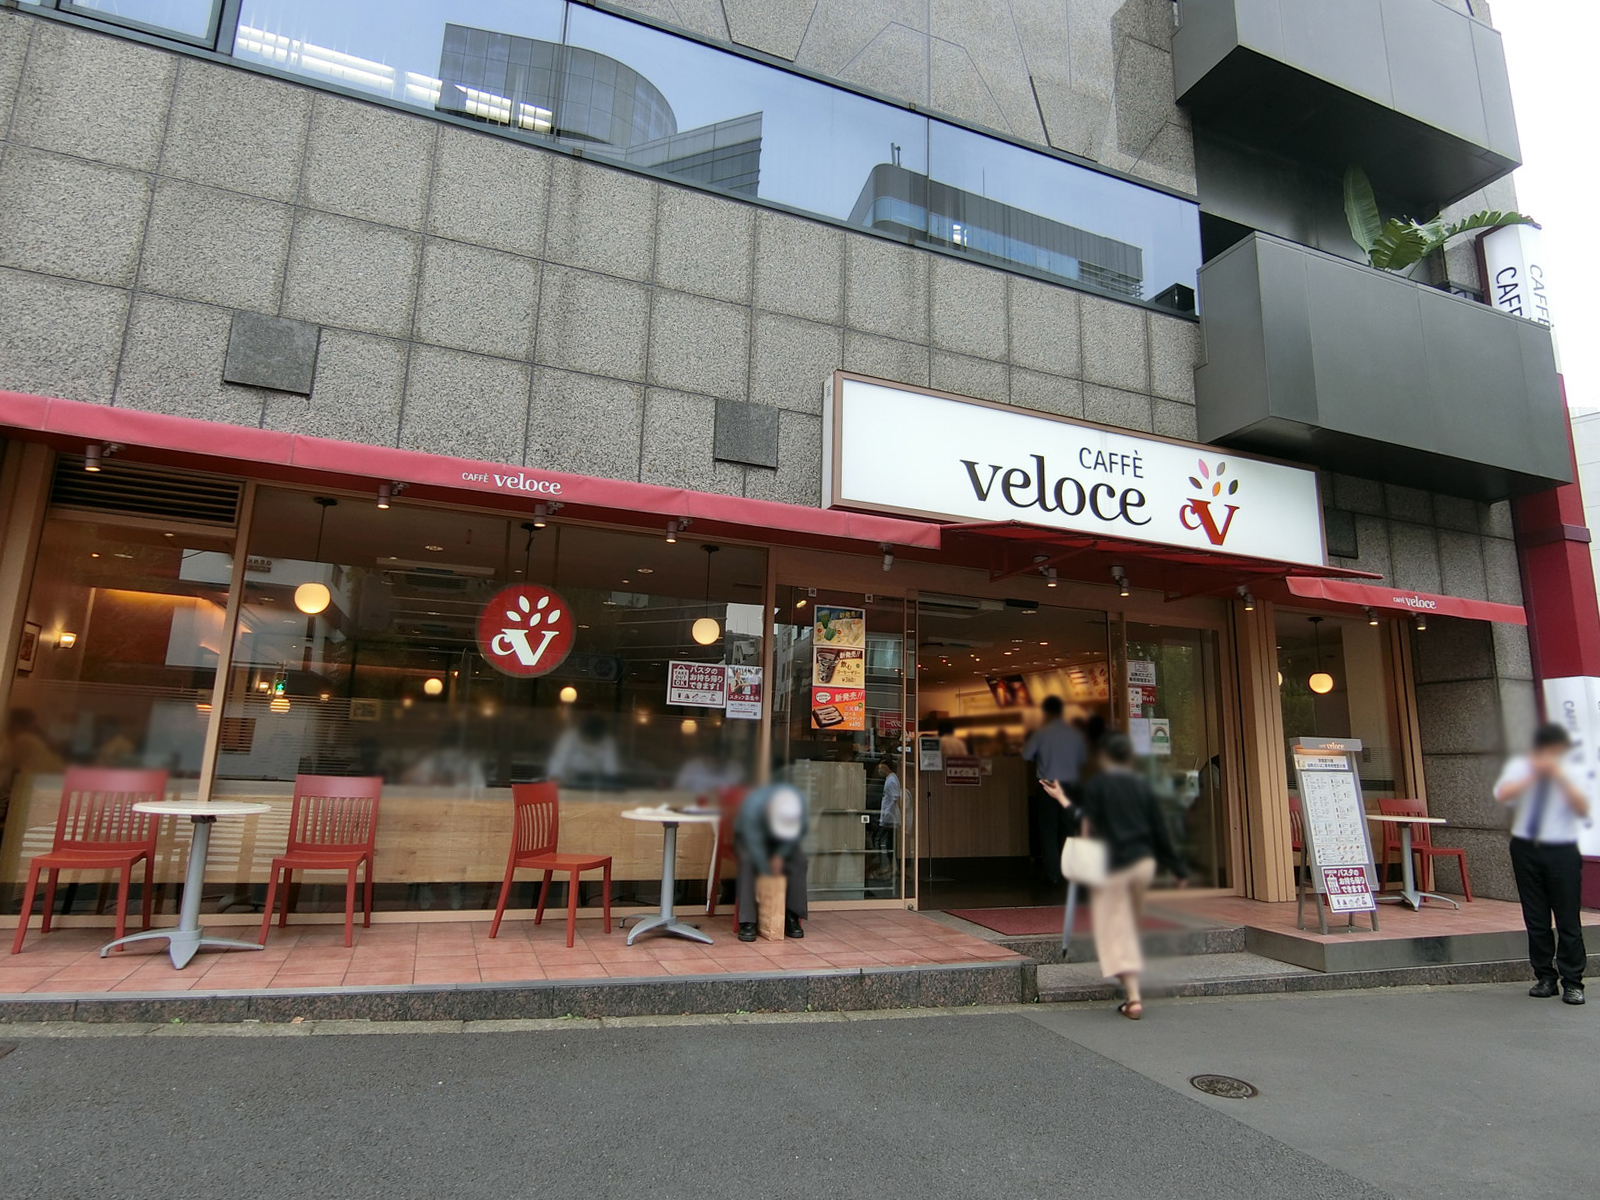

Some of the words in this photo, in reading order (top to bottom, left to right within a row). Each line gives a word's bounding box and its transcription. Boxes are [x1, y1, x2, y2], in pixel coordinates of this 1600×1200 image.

[1496, 266, 1523, 317] CAFF
[1078, 447, 1144, 479] CAFFÈ
[462, 472, 489, 483] CAFFÈ
[493, 472, 563, 495] veloce
[959, 453, 1152, 526] veloce
[1405, 595, 1437, 610] veloce
[689, 673, 723, 683] お持ち帰り
[690, 665, 718, 675] パスタの
